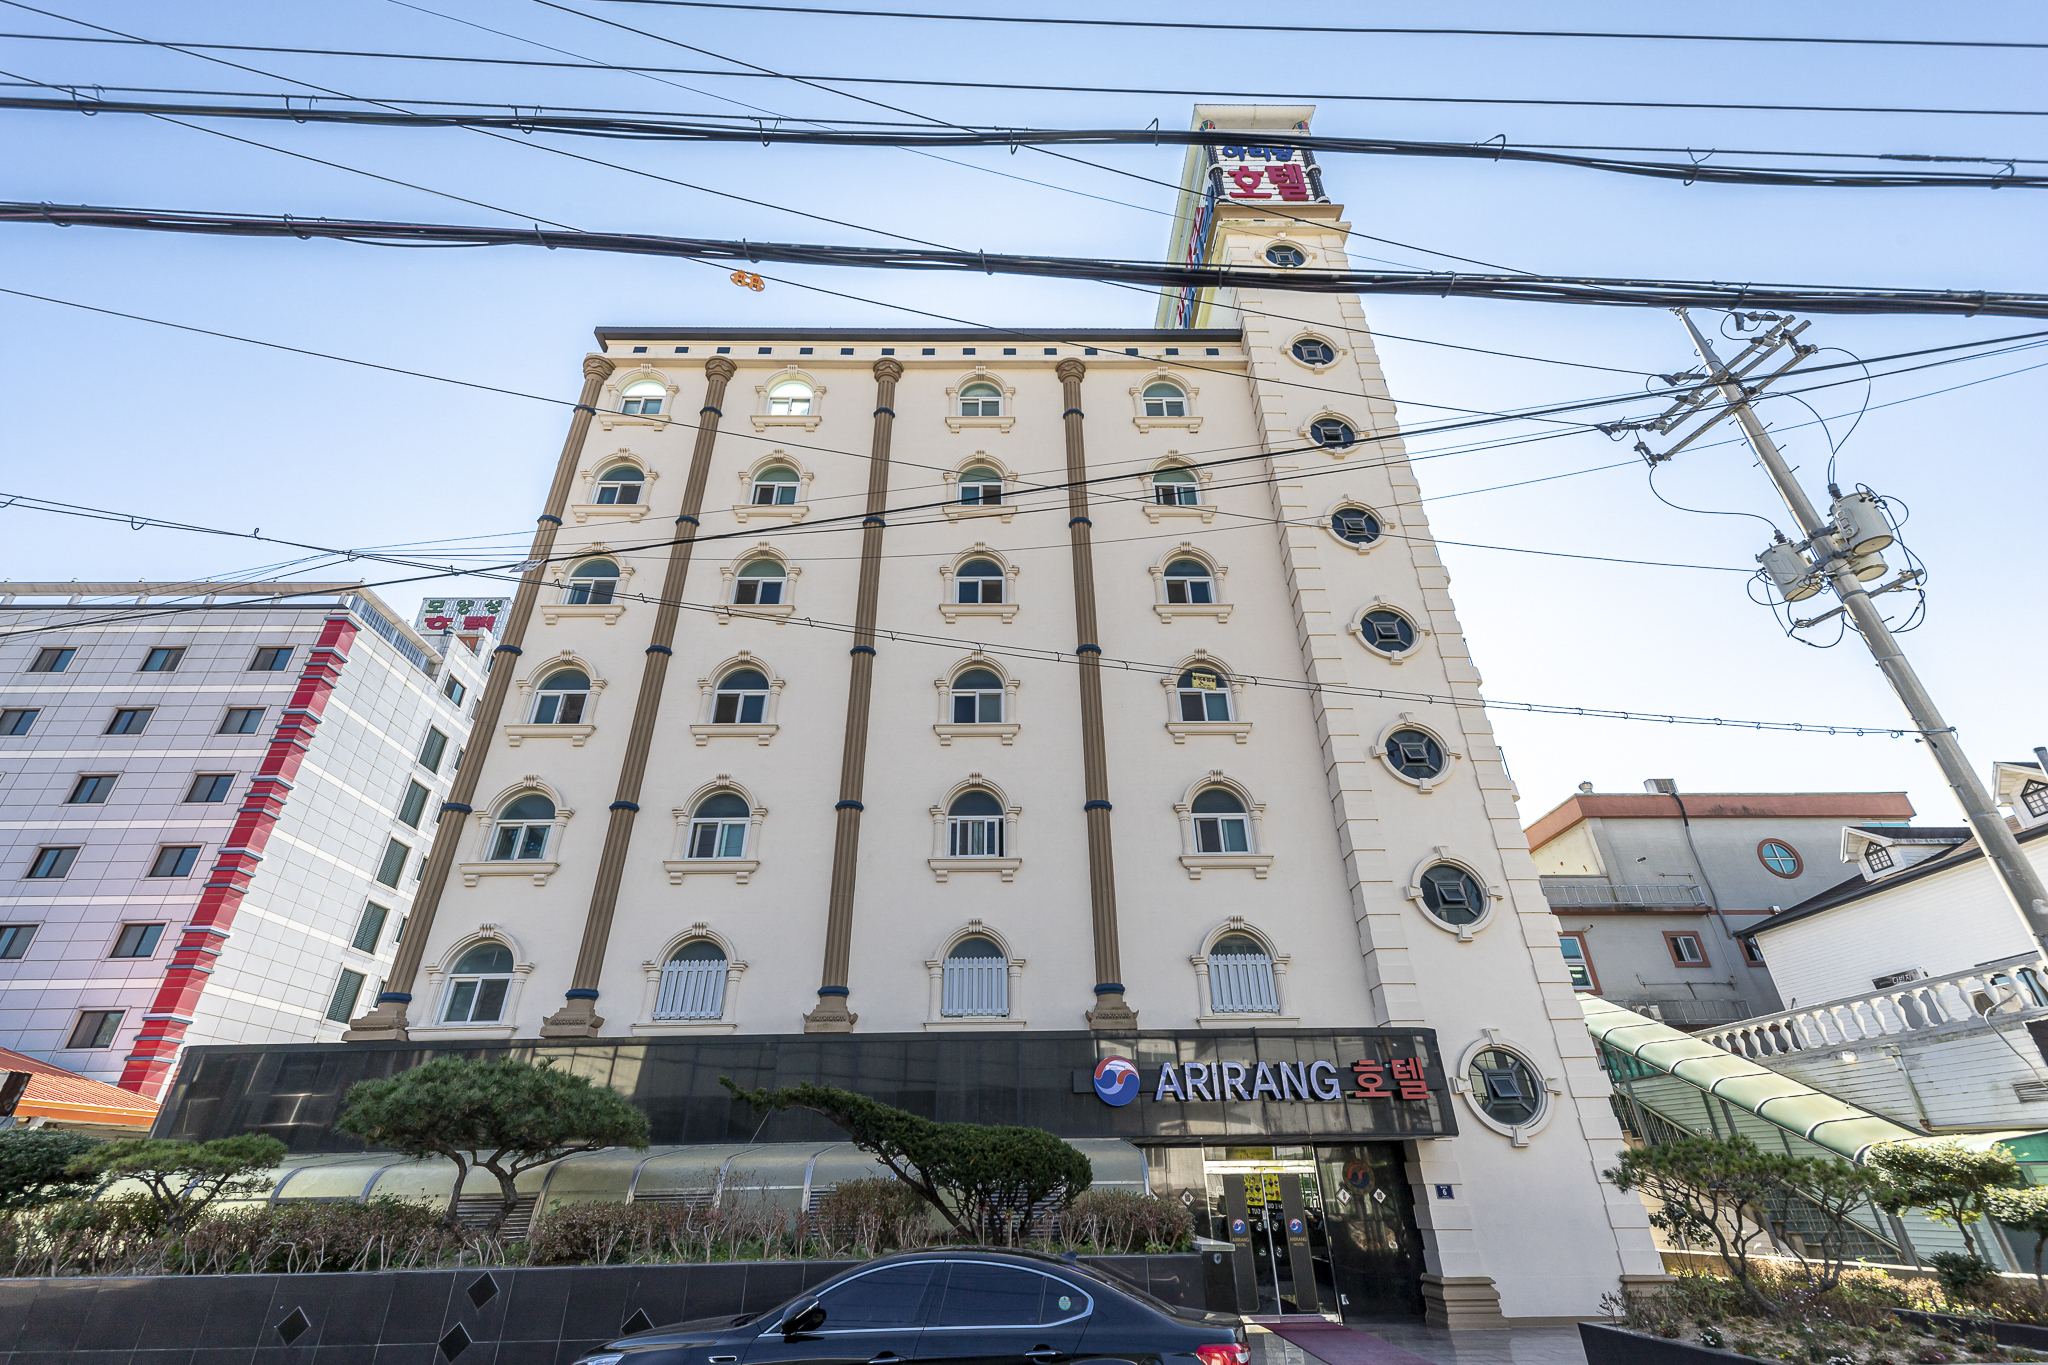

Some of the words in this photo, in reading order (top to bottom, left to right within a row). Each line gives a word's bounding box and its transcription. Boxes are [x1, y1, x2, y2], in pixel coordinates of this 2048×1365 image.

[1228, 164, 1310, 201] 호텔
[1155, 1060, 1341, 1100] ARIRANG
[1352, 1057, 1431, 1100] 호텔
